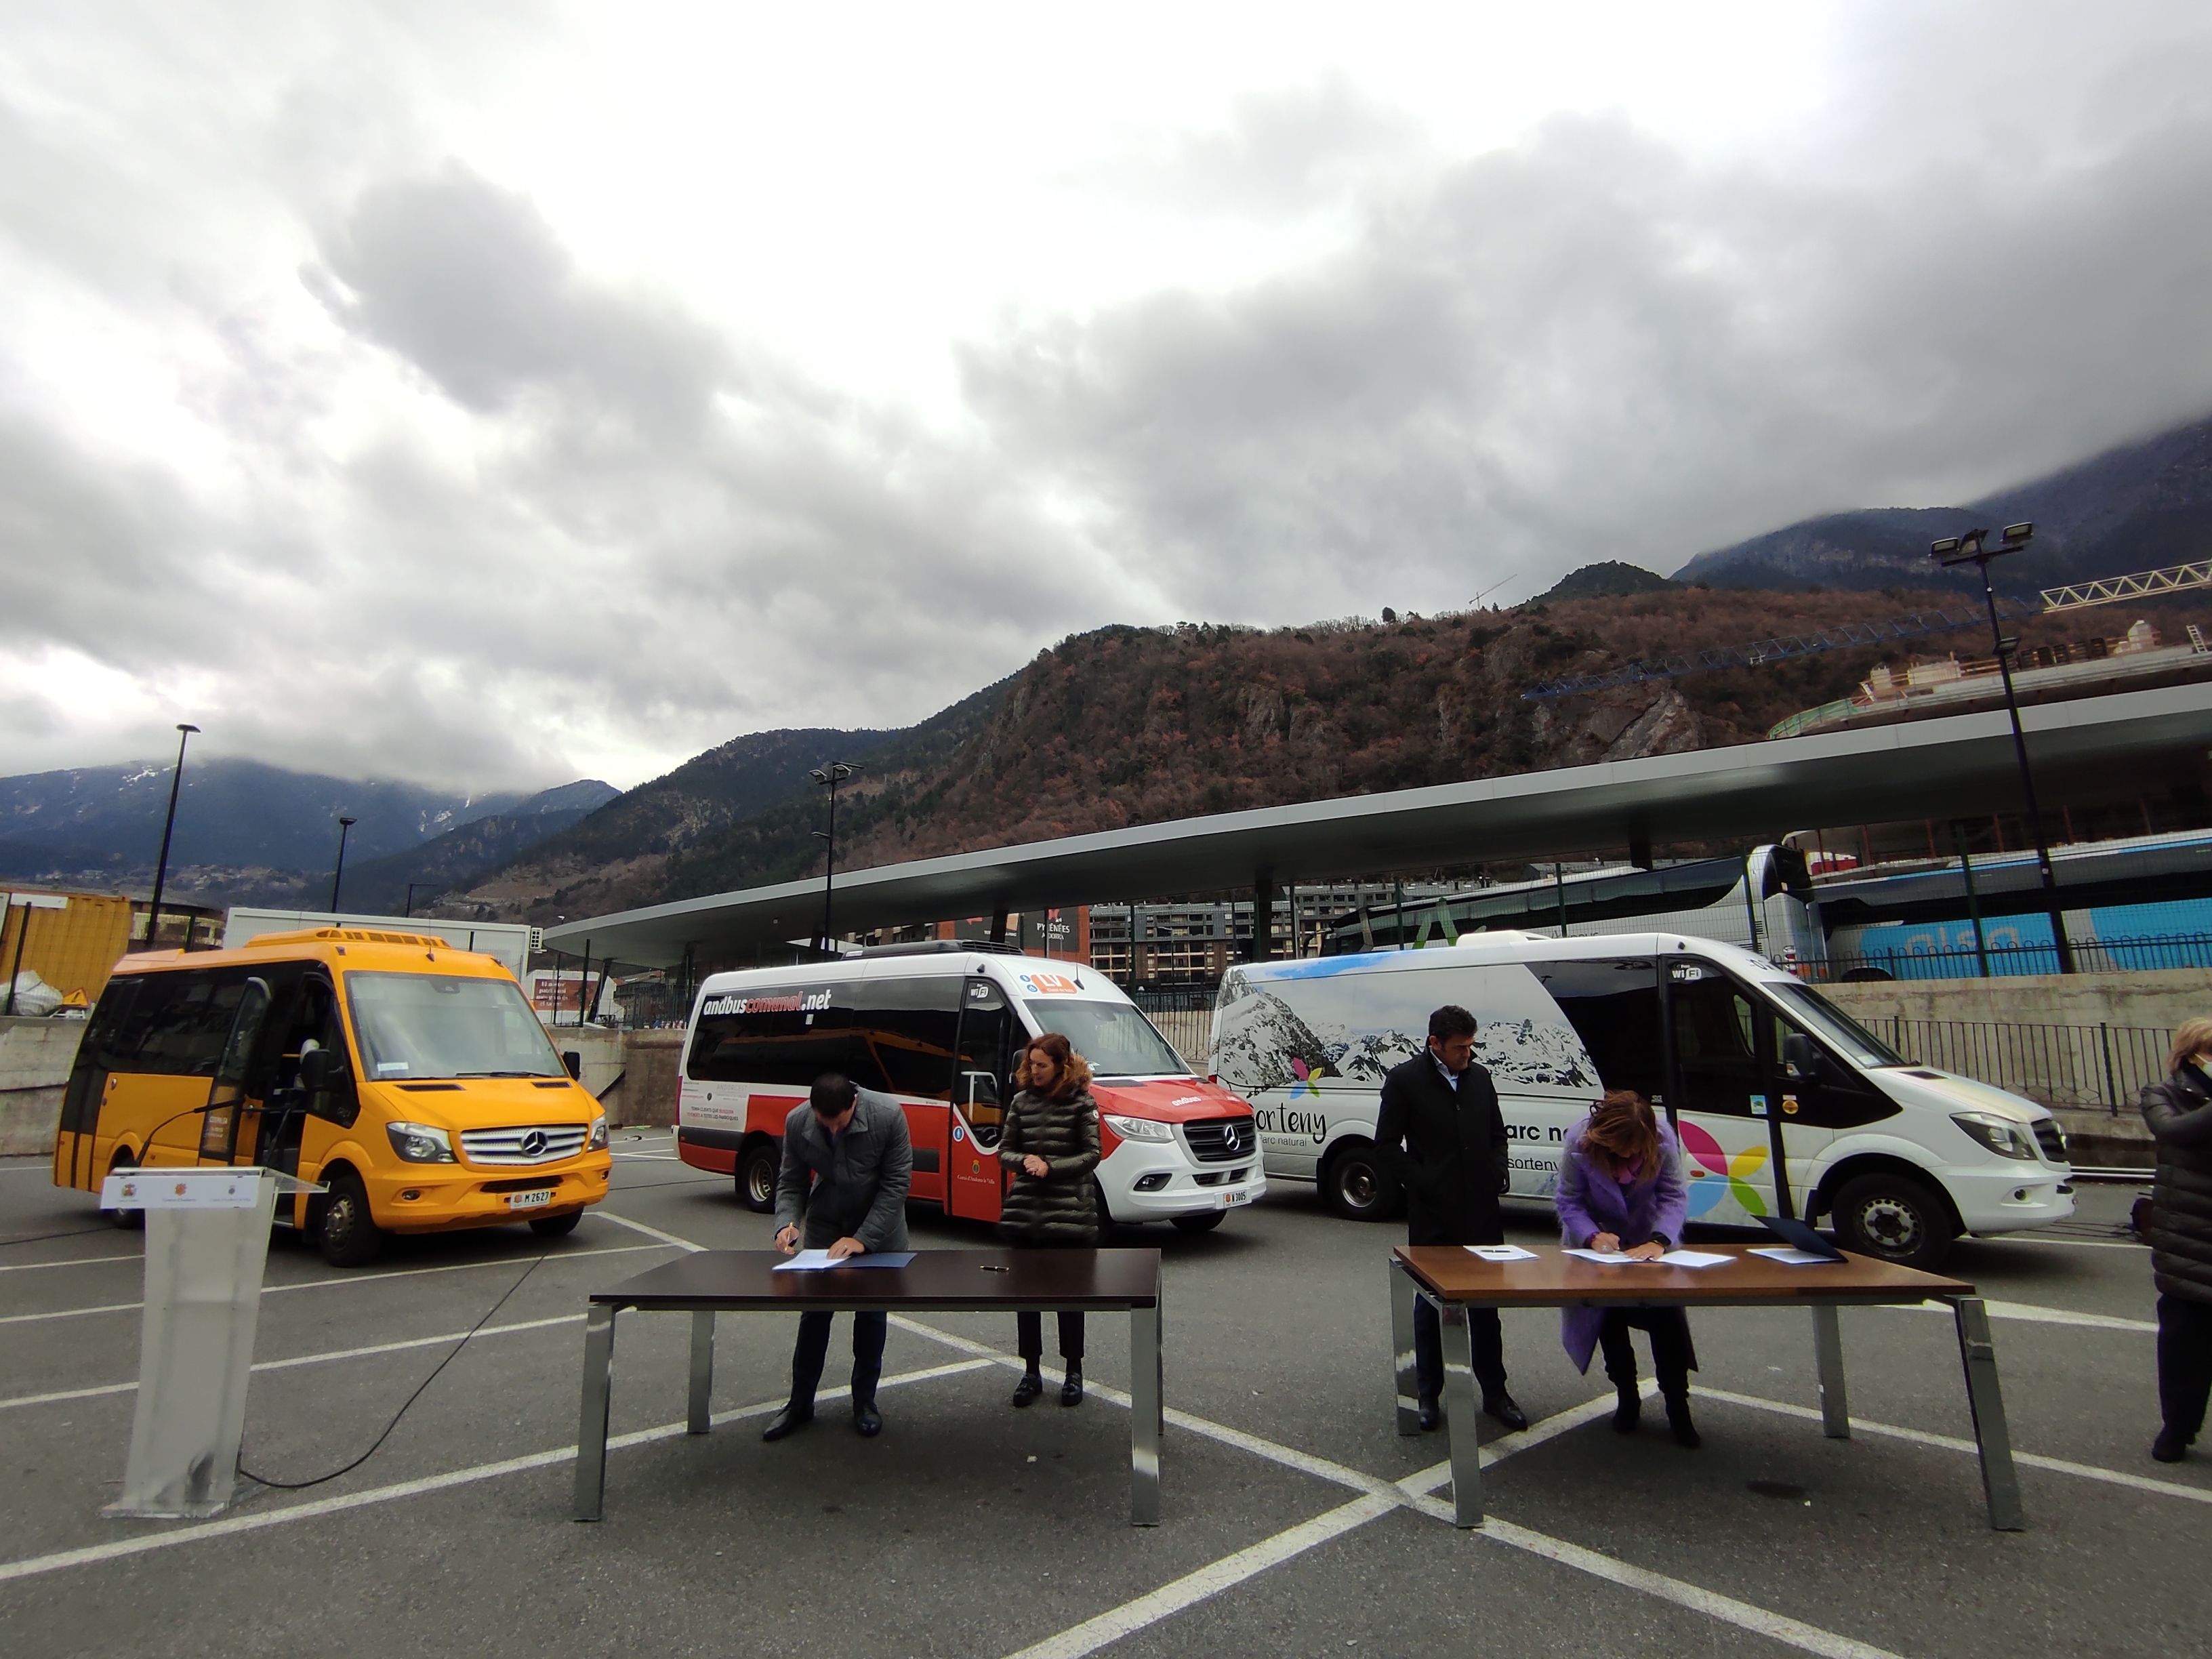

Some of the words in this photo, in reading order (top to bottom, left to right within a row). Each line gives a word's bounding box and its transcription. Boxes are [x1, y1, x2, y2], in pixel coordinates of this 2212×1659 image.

[1037, 922, 1070, 933] PYÉNÉES
[1042, 932, 1065, 940] ADORRA
[1255, 1102, 1327, 1145] orteny
[1504, 1124, 1540, 1141] arc
[1277, 1136, 1307, 1147] natural
